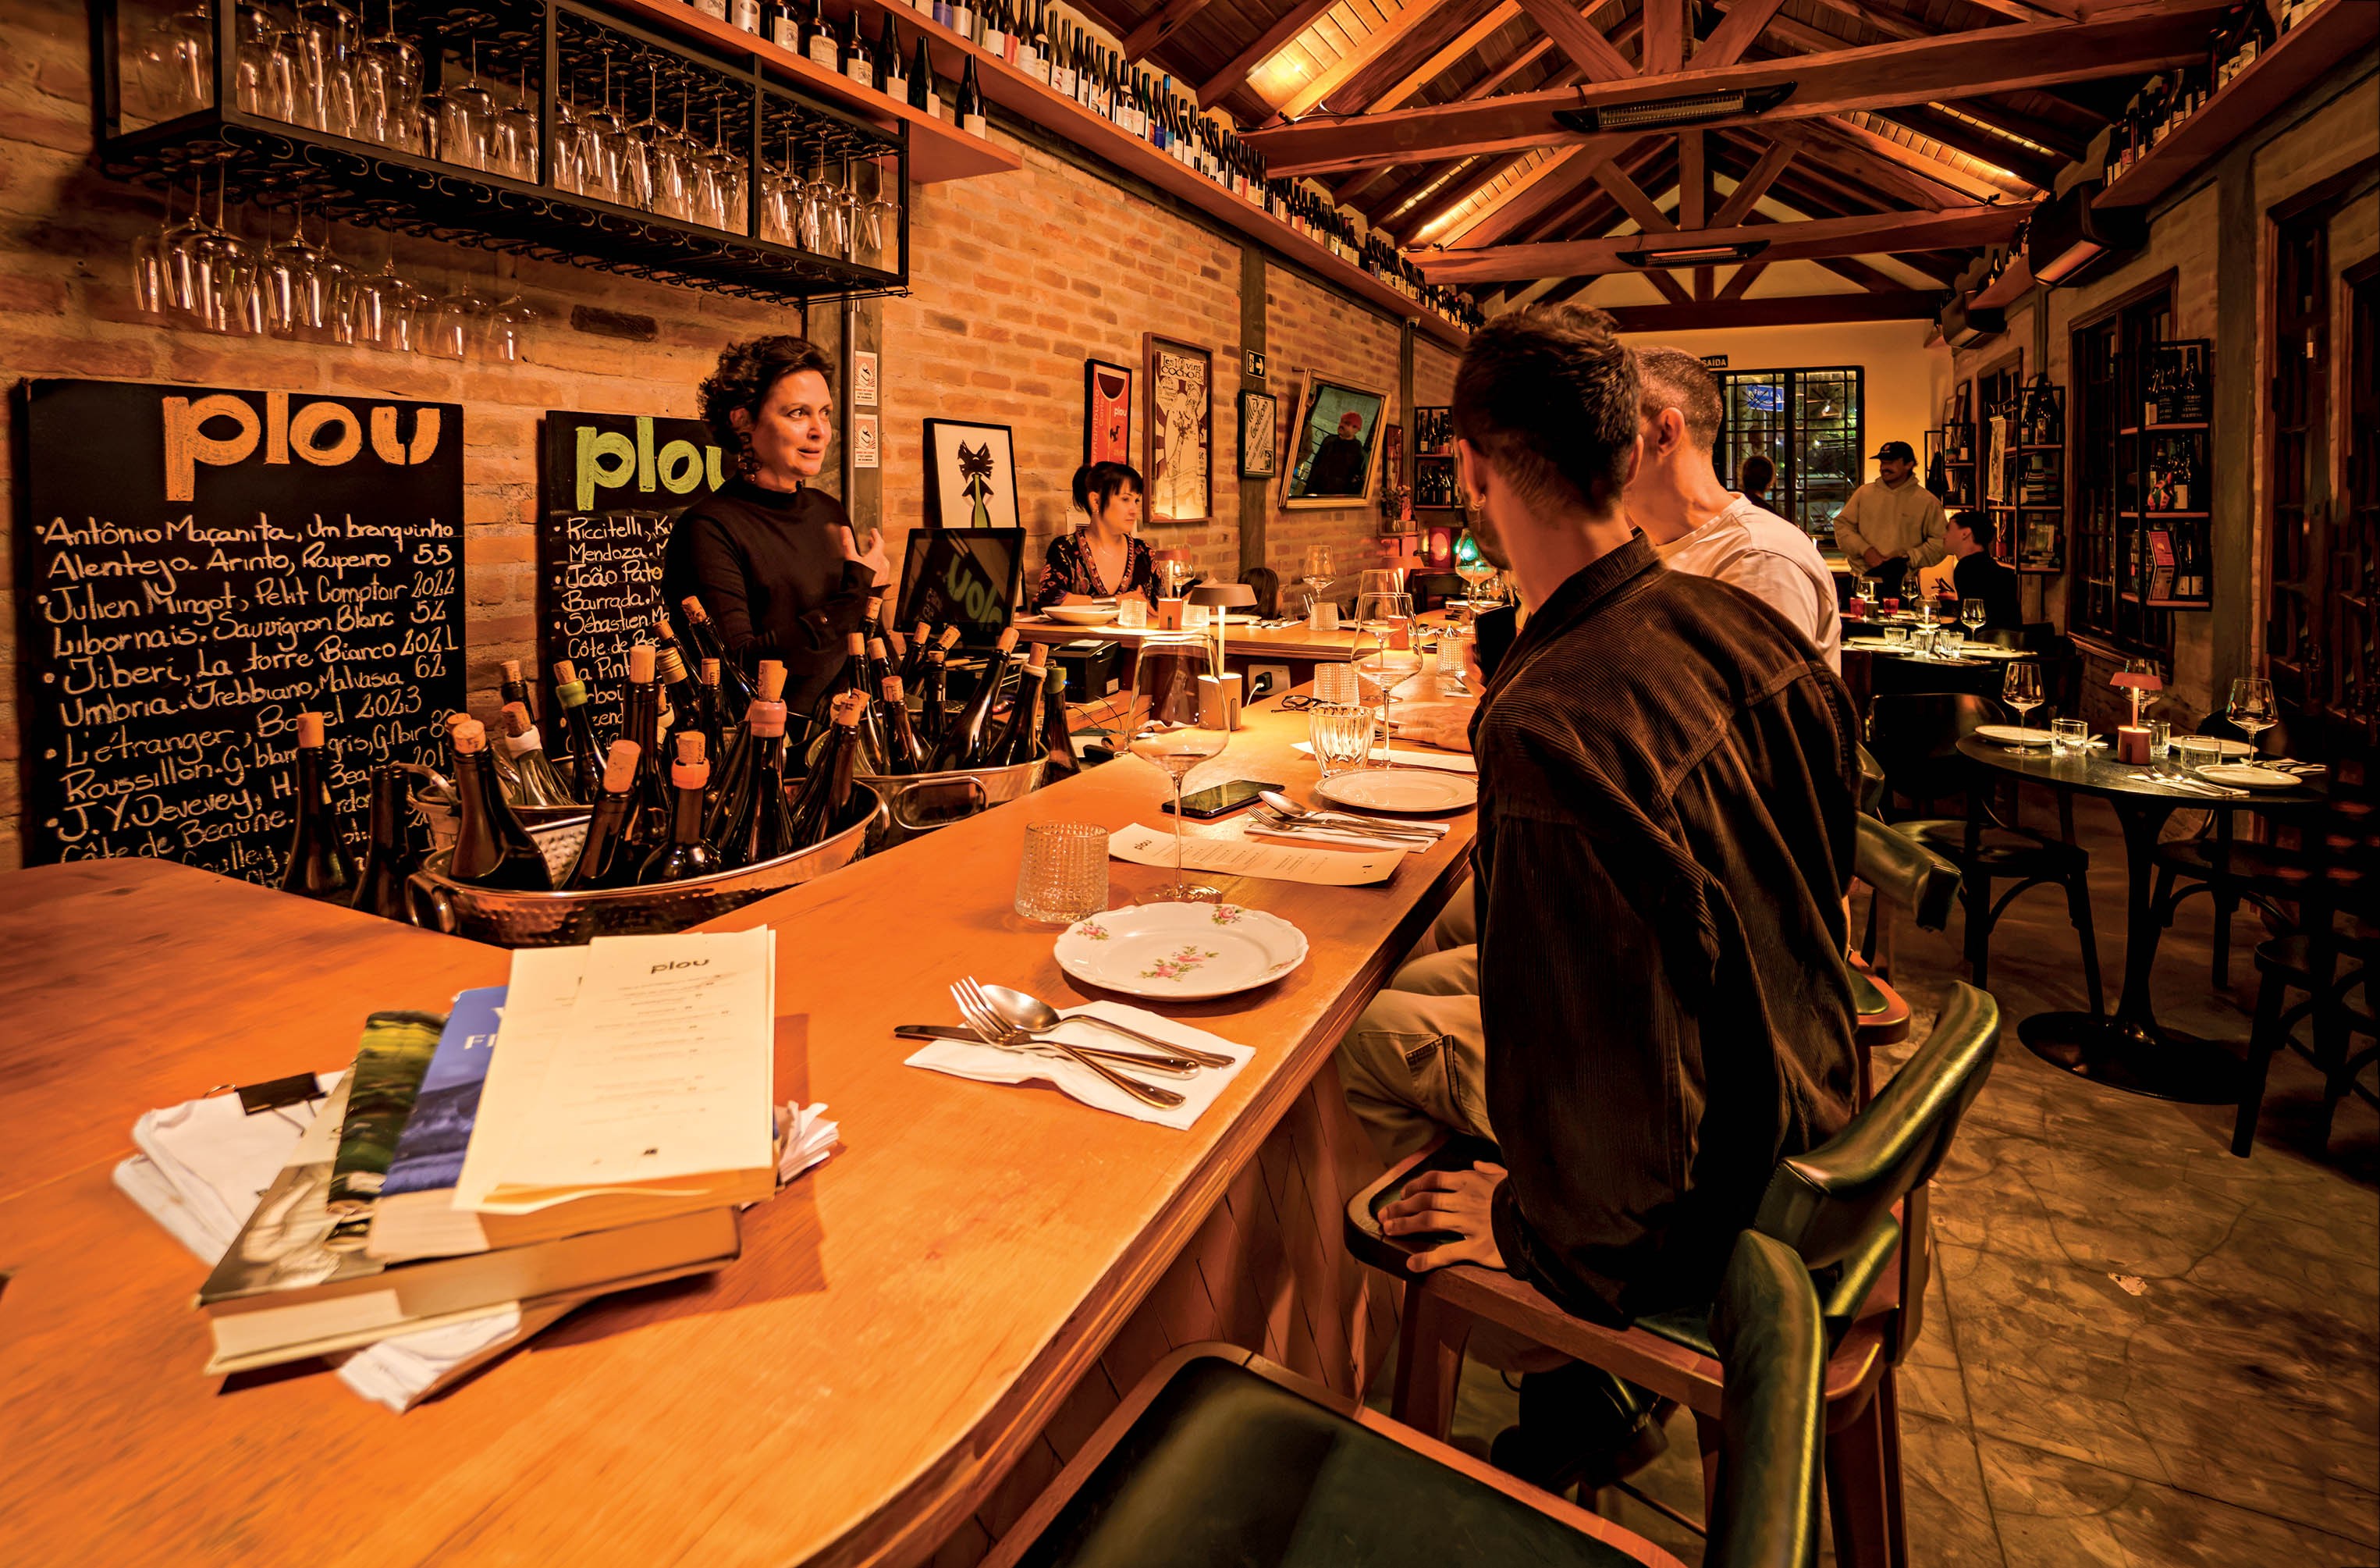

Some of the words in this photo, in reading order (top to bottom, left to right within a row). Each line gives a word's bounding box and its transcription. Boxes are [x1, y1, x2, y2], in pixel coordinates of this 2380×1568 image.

[1186, 362, 1202, 372] vins
[1702, 357, 1727, 367] SAÍDA
[1114, 406, 1128, 418] plou
[162, 391, 441, 502] plou
[43, 517, 162, 546] Antônio
[165, 511, 302, 547] Maçanita,
[346, 514, 454, 553] branquinho
[570, 542, 653, 564] Mendoza.
[48, 549, 198, 596] Alentejo.
[206, 542, 295, 577] Arinto,
[413, 544, 453, 566] 55
[566, 564, 618, 588] João
[622, 560, 663, 582] Pato
[44, 582, 140, 624] Julien
[255, 576, 309, 606] Petit
[317, 572, 408, 612] Comptoir
[410, 567, 456, 599] 2022
[561, 585, 650, 612] Bairrada.
[212, 611, 332, 652] Sauvignon
[336, 604, 395, 632] Blanc
[410, 599, 446, 624] 52
[563, 606, 648, 636] Sébastien
[197, 649, 233, 677] La
[314, 634, 396, 663] Bianco
[400, 624, 459, 656] 2021
[568, 636, 606, 659] Côte
[611, 634, 631, 654] de
[59, 692, 188, 727] Umbria.
[318, 665, 405, 692] Malvasia
[414, 653, 446, 678] 62
[354, 684, 422, 719] 2023
[137, 830, 176, 858] de
[176, 810, 295, 849] Beaune.
[1134, 839, 1153, 852] plou
[651, 958, 710, 975] plou
